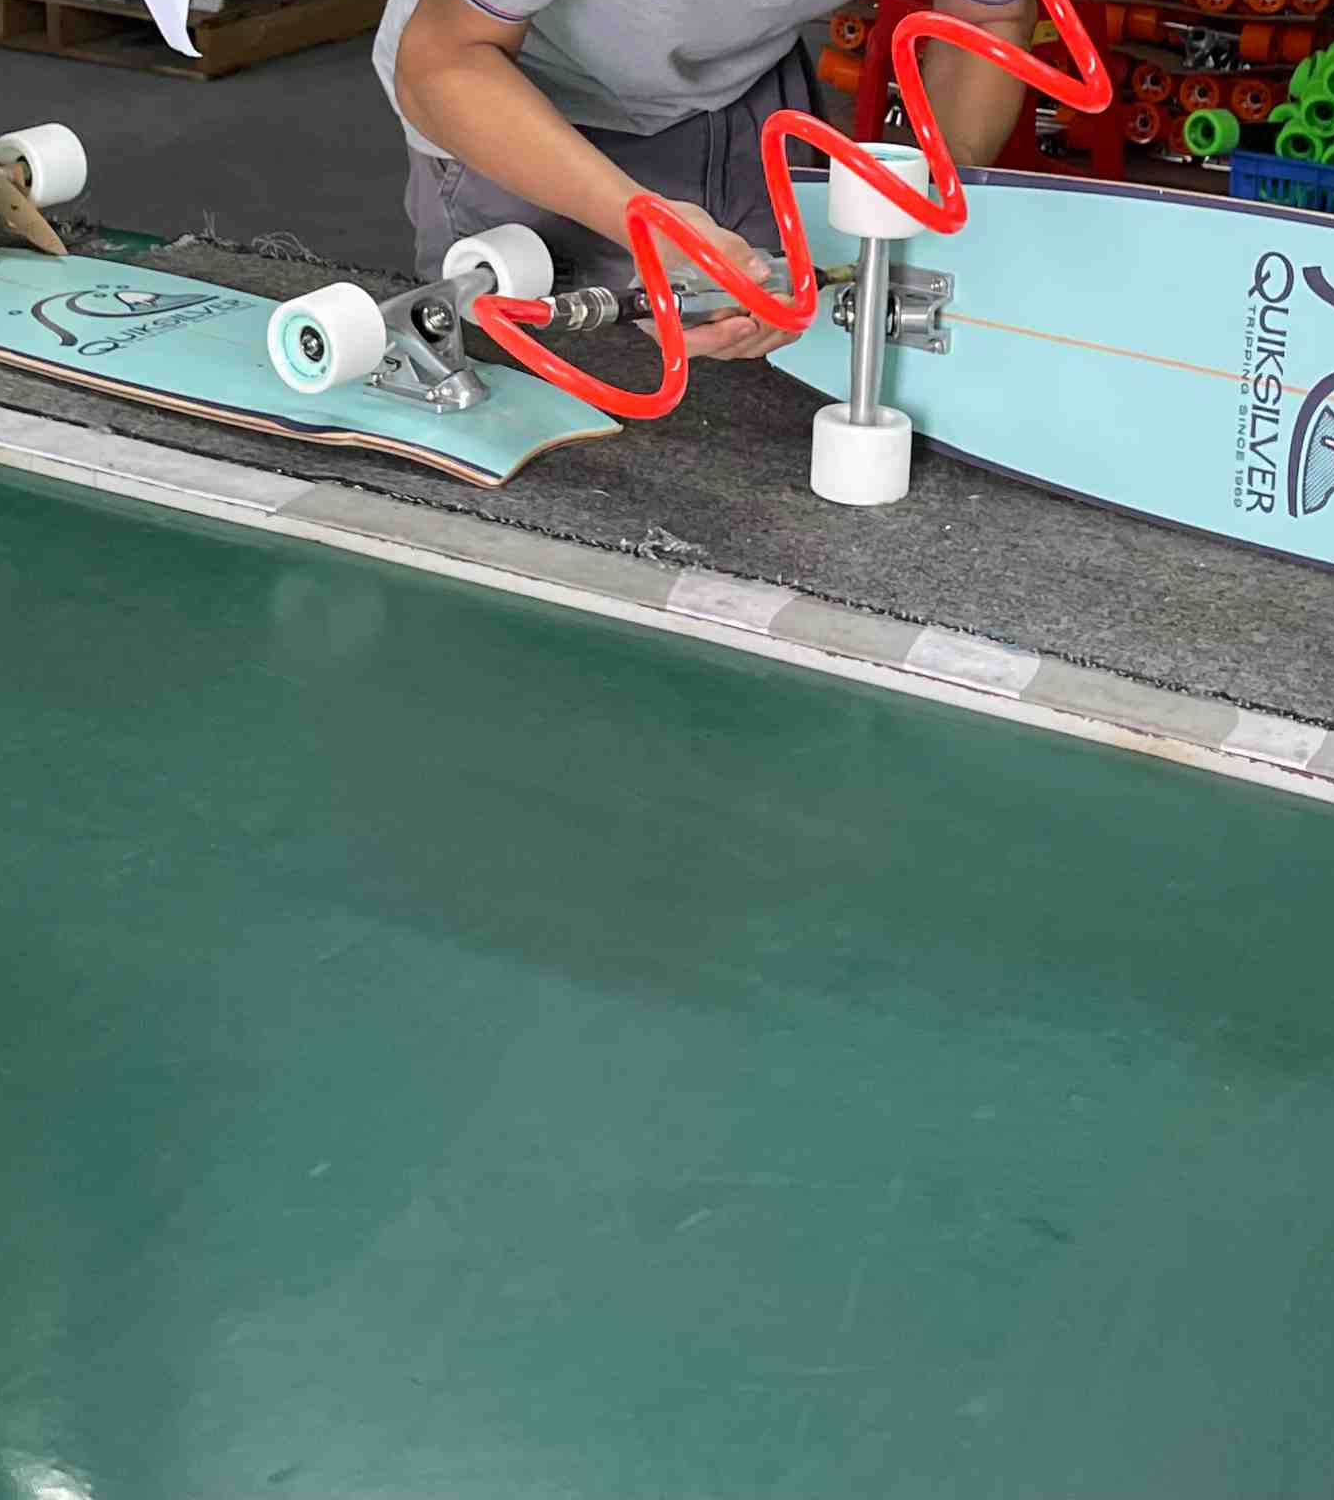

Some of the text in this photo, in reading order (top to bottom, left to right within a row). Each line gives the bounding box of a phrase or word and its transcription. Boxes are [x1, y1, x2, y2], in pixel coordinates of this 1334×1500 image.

[1239, 304, 1257, 395] TRIPPING
[1247, 251, 1295, 514] QUIKSILVER
[1235, 404, 1248, 461] SINCE
